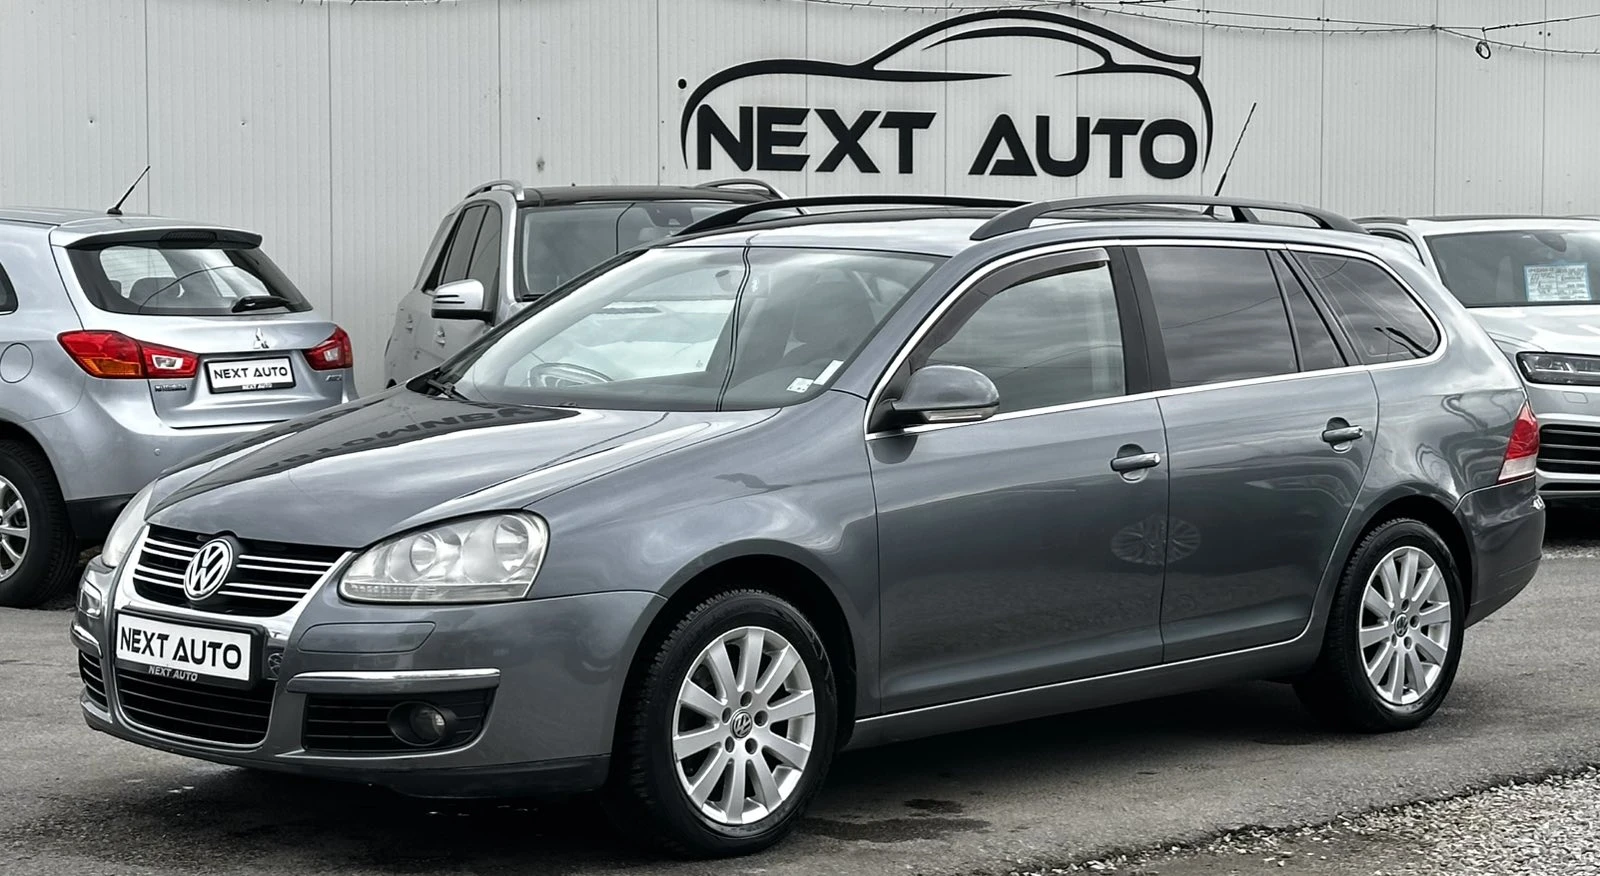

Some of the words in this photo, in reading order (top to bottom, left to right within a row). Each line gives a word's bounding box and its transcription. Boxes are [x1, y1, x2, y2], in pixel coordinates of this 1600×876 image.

[697, 104, 936, 174] NEXT
[968, 113, 1198, 179] AUTO
[214, 367, 249, 379] NEXT
[253, 366, 288, 378] AUTO
[186, 541, 230, 597] VW
[120, 626, 169, 658] NEXT
[172, 637, 242, 670] AUTO
[148, 665, 172, 678] NEXT
[173, 670, 199, 682] AUTO
